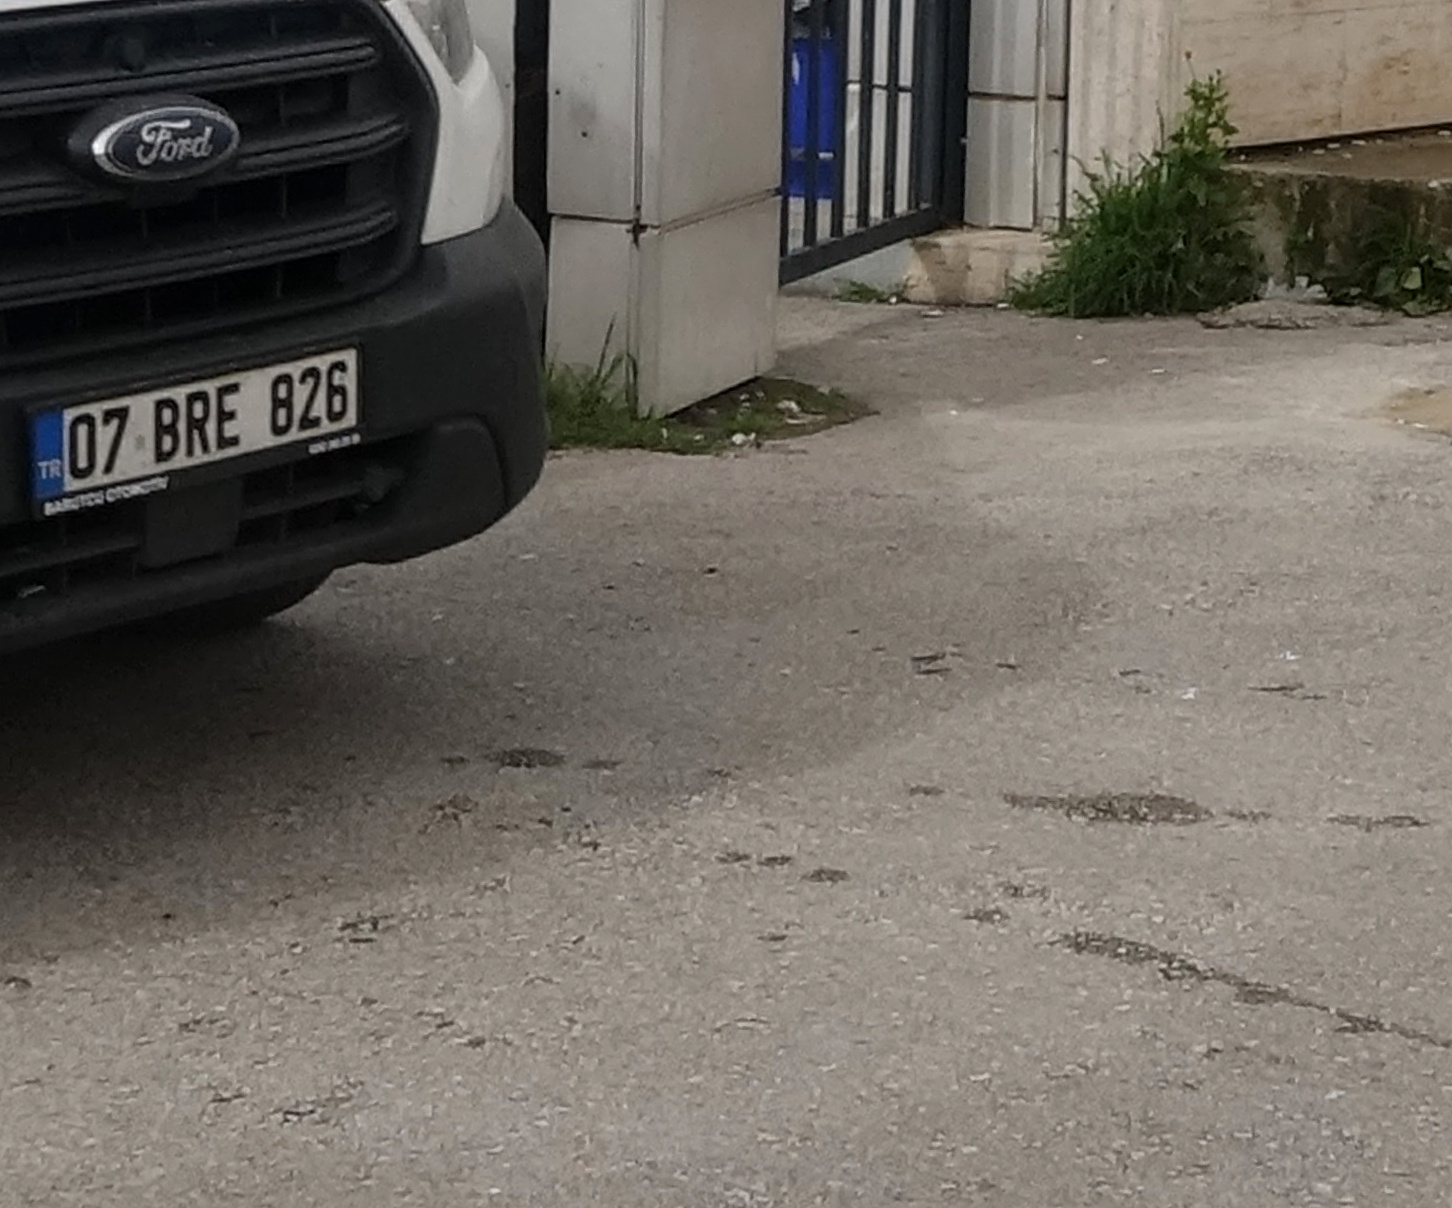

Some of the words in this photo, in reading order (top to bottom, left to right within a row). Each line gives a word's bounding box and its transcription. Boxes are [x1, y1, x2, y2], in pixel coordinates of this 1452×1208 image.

[136, 118, 214, 167] Ford
[68, 405, 130, 480] 07
[154, 382, 241, 464] BRE
[270, 360, 348, 437] 826
[38, 459, 63, 480] TR
